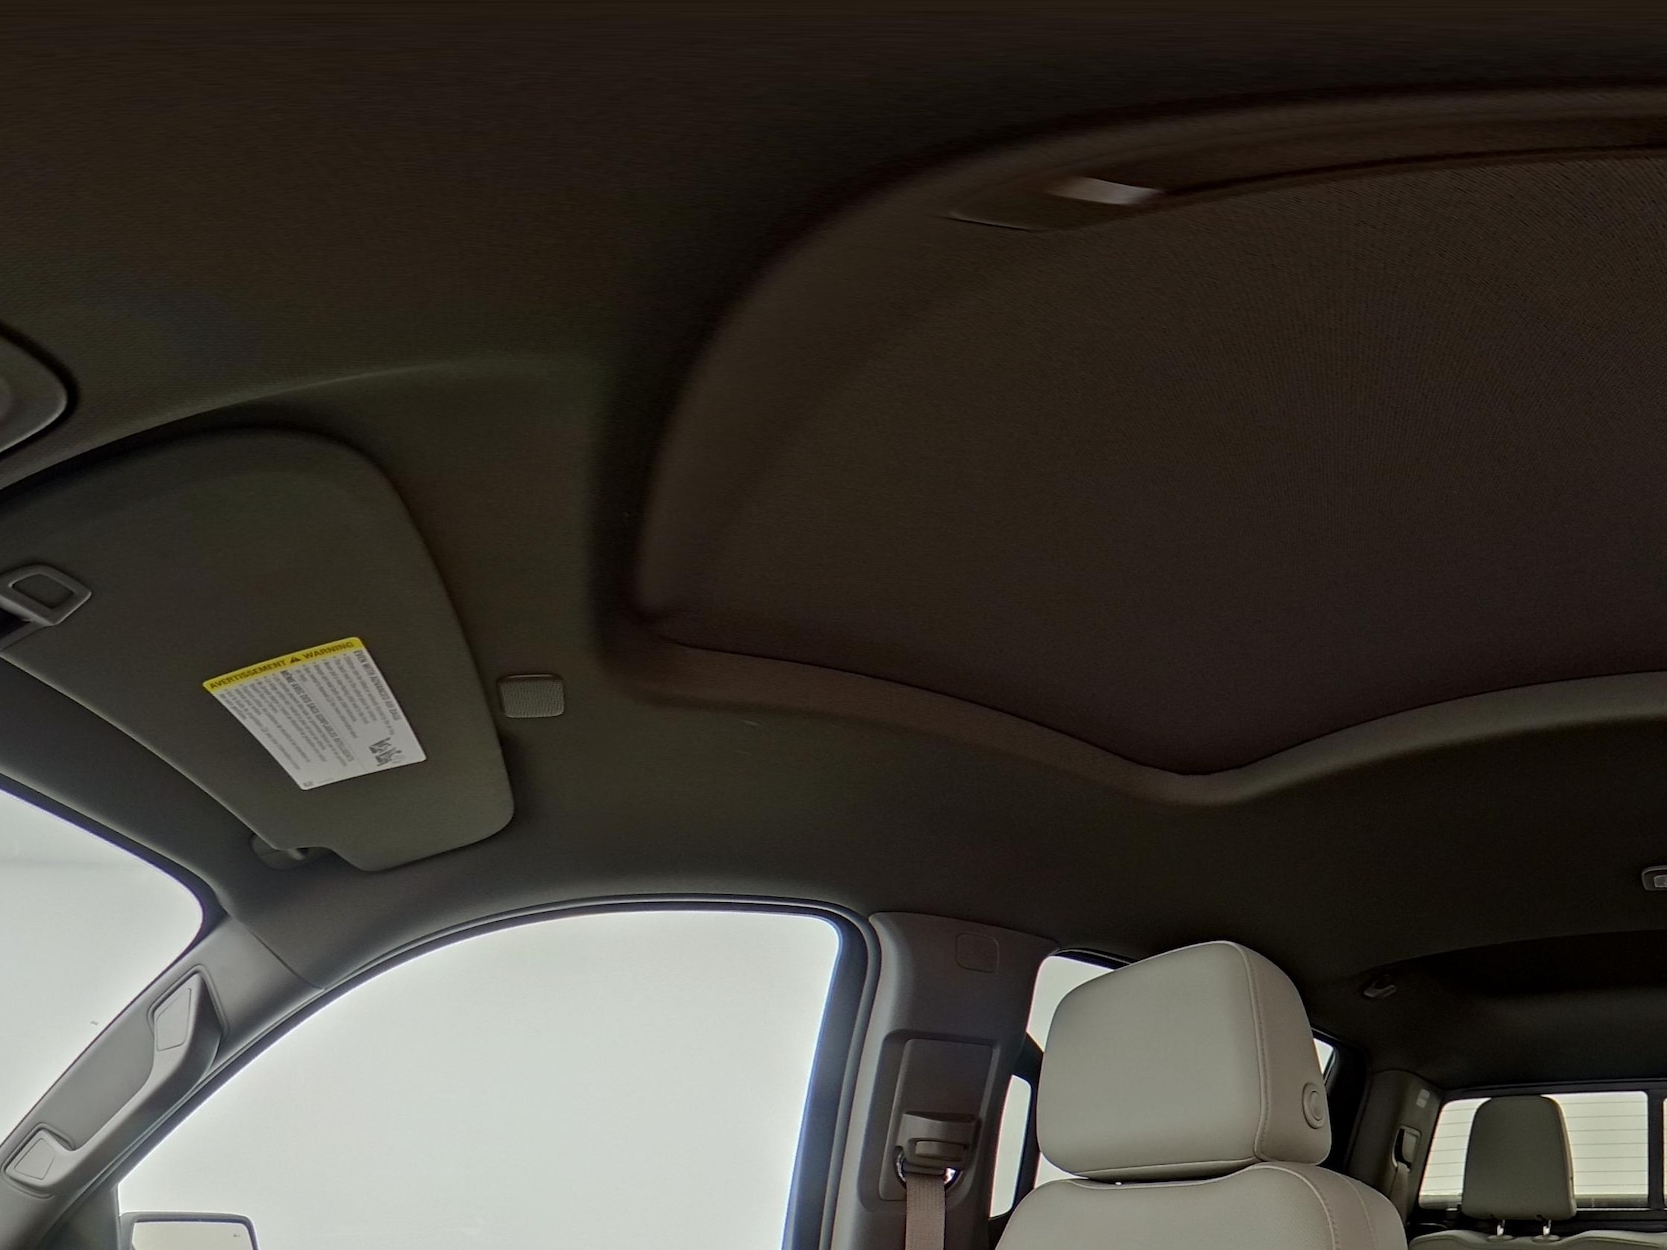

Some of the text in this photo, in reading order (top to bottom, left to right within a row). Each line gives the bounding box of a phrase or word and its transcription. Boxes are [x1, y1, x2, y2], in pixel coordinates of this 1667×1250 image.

[206, 659, 288, 689] AVERTISSEMENT
[301, 640, 354, 661] WARNING
[352, 648, 368, 663] EVEN
